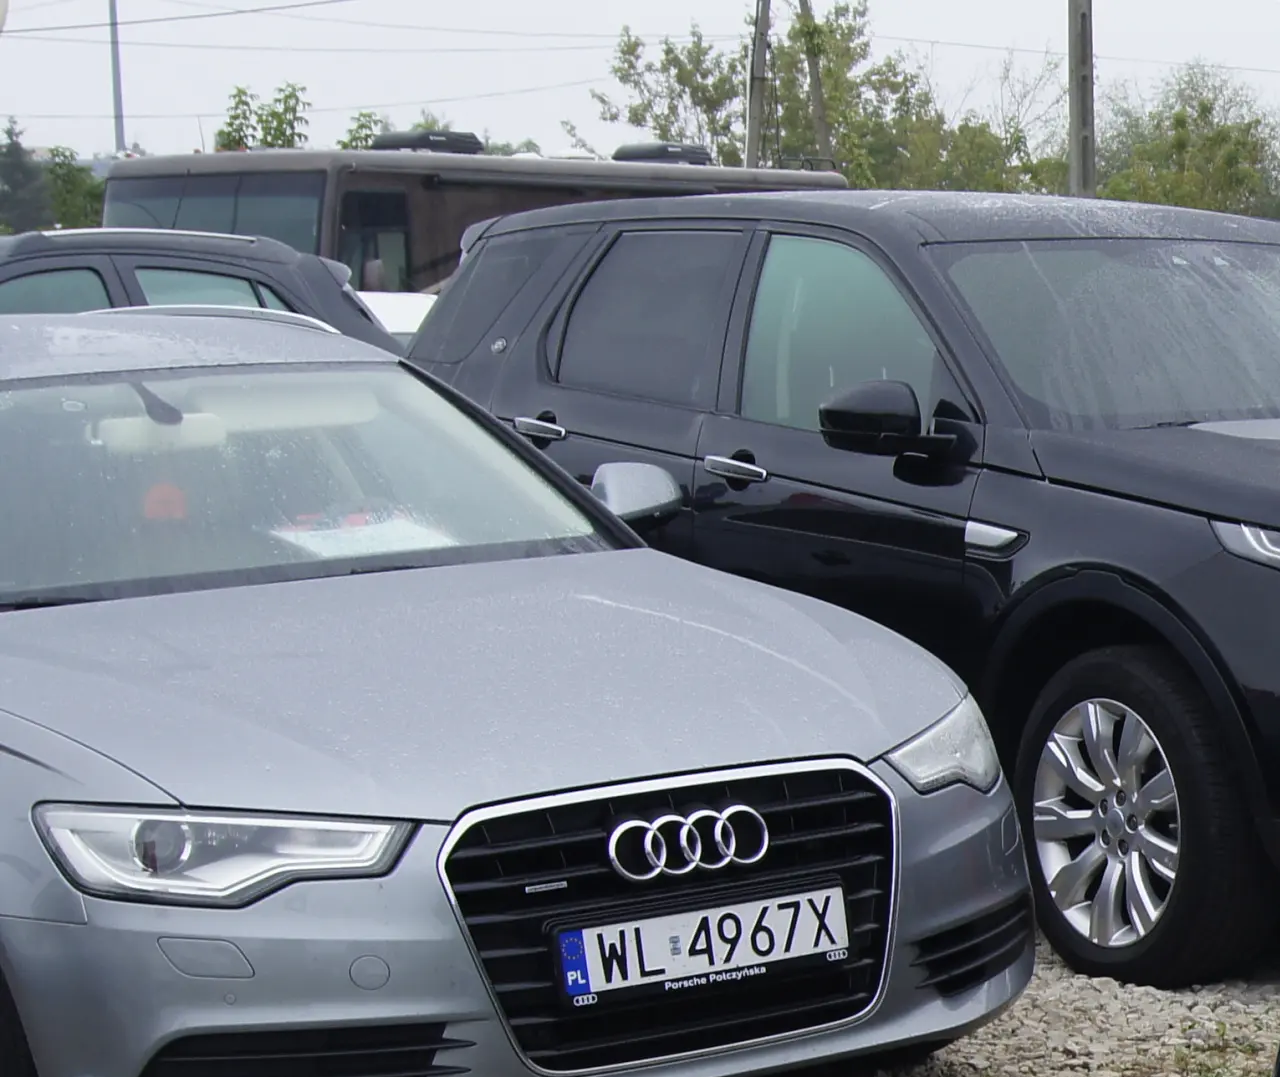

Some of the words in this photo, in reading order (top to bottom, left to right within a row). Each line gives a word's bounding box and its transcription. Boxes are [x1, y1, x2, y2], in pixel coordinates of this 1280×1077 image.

[597, 927, 667, 984] WL
[687, 895, 838, 966] 4967X
[566, 969, 587, 986] PL
[664, 975, 707, 991] Porsche
